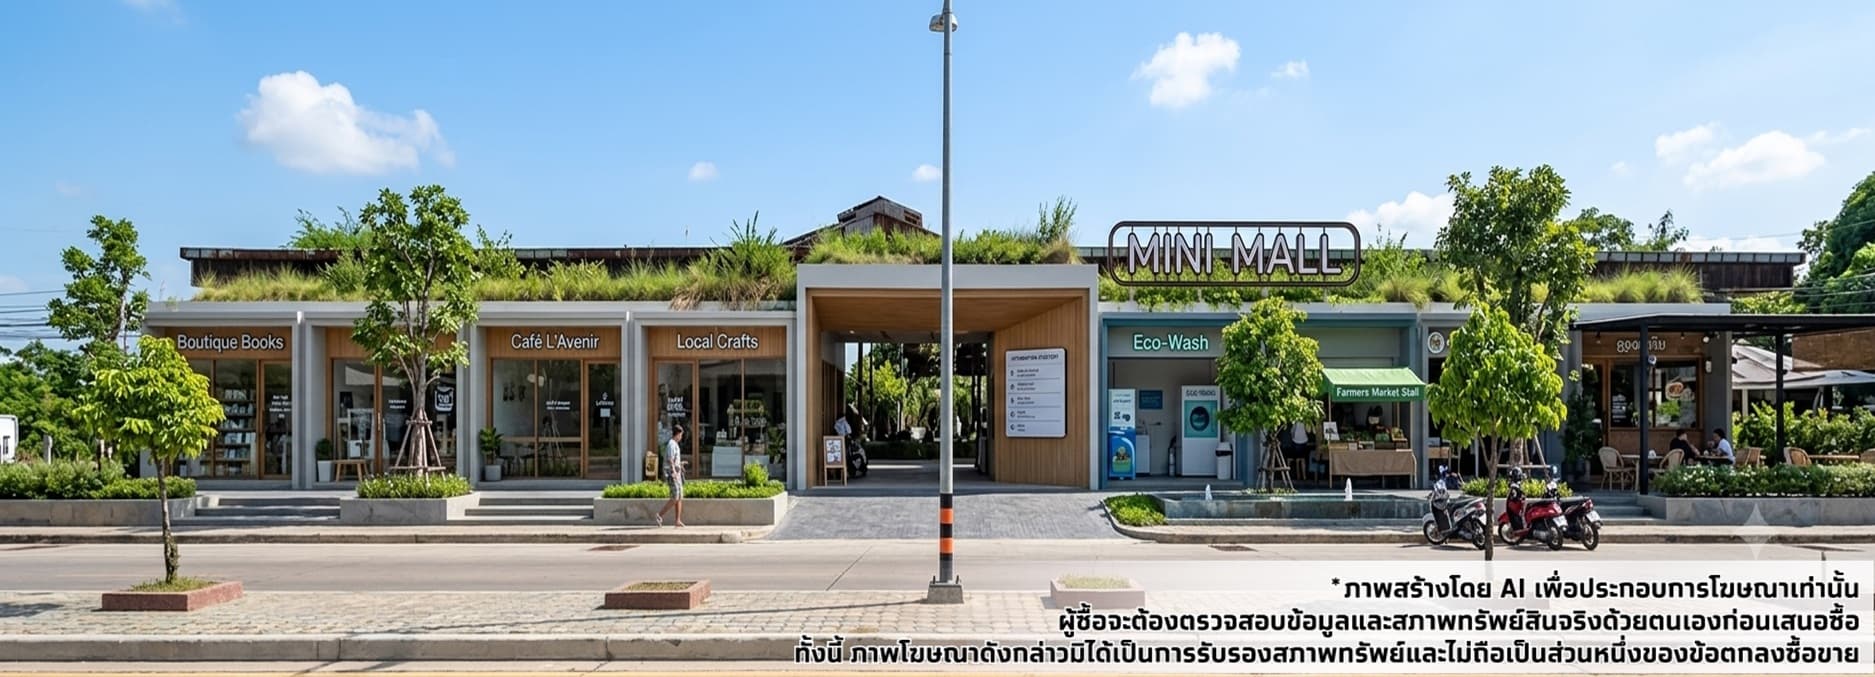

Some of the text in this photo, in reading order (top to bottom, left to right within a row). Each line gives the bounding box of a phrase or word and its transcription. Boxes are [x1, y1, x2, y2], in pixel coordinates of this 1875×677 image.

[1127, 231, 1344, 275] MINI MALL
[177, 334, 285, 353] Boutique Books
[511, 333, 600, 350] Café L'Avenir
[677, 333, 759, 350] Local Crafts
[1132, 333, 1209, 352] Eco-Wash
[1335, 386, 1420, 398] Farmers Market Stall
